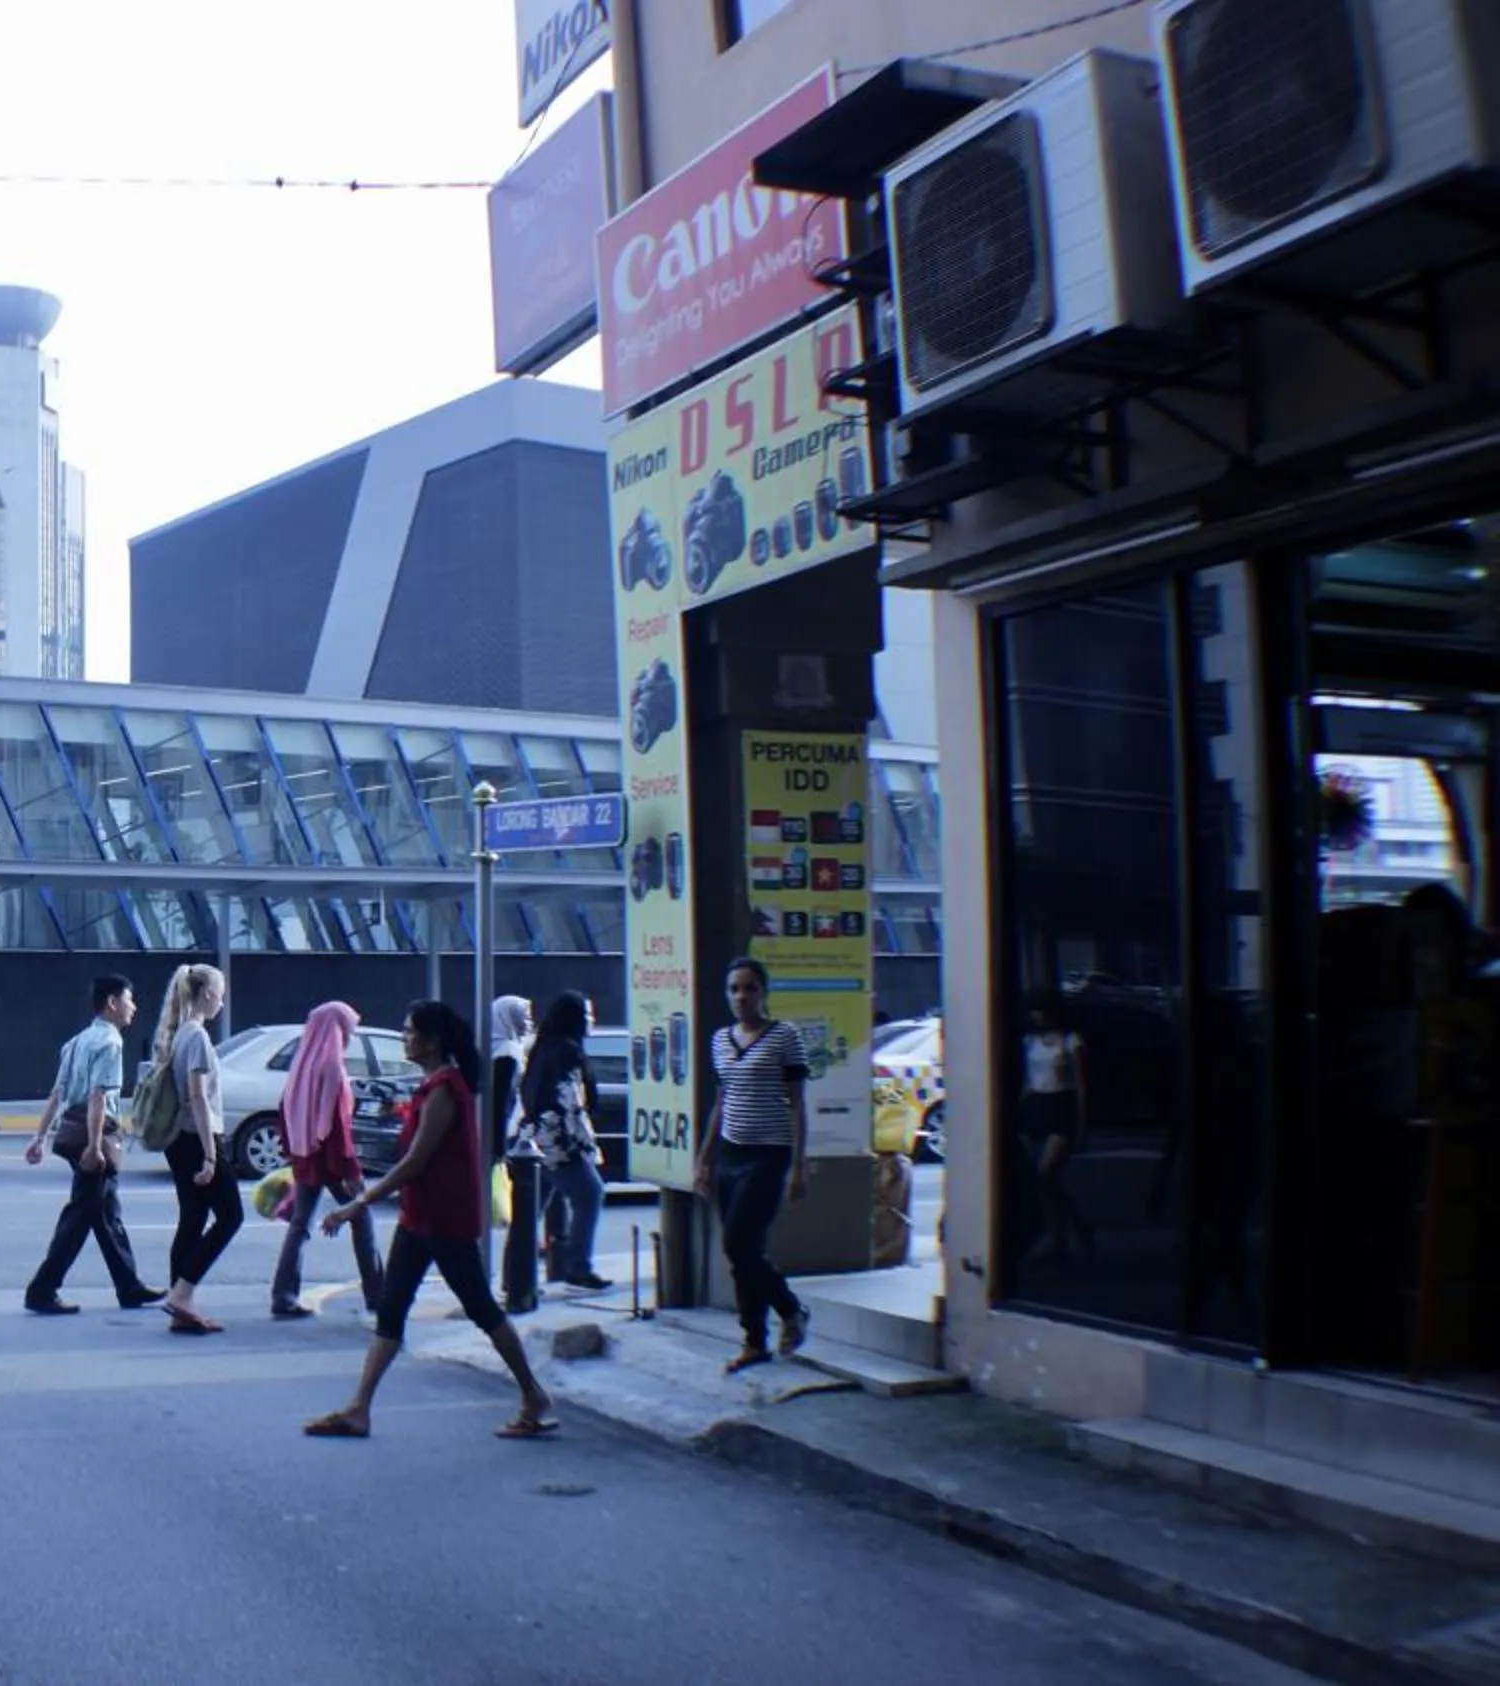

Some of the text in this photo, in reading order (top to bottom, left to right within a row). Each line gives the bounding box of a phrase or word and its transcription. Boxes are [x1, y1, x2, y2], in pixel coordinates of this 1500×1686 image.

[706, 273, 745, 311] You
[751, 224, 824, 290] Always
[752, 415, 858, 481] Camera
[613, 447, 667, 493] Nikon
[751, 742, 860, 765] PERCUMA
[784, 768, 830, 792] IDD
[594, 803, 612, 825] 22
[643, 934, 674, 956] Lens
[633, 964, 688, 997] Cleaning
[634, 1108, 689, 1151] DSLR
